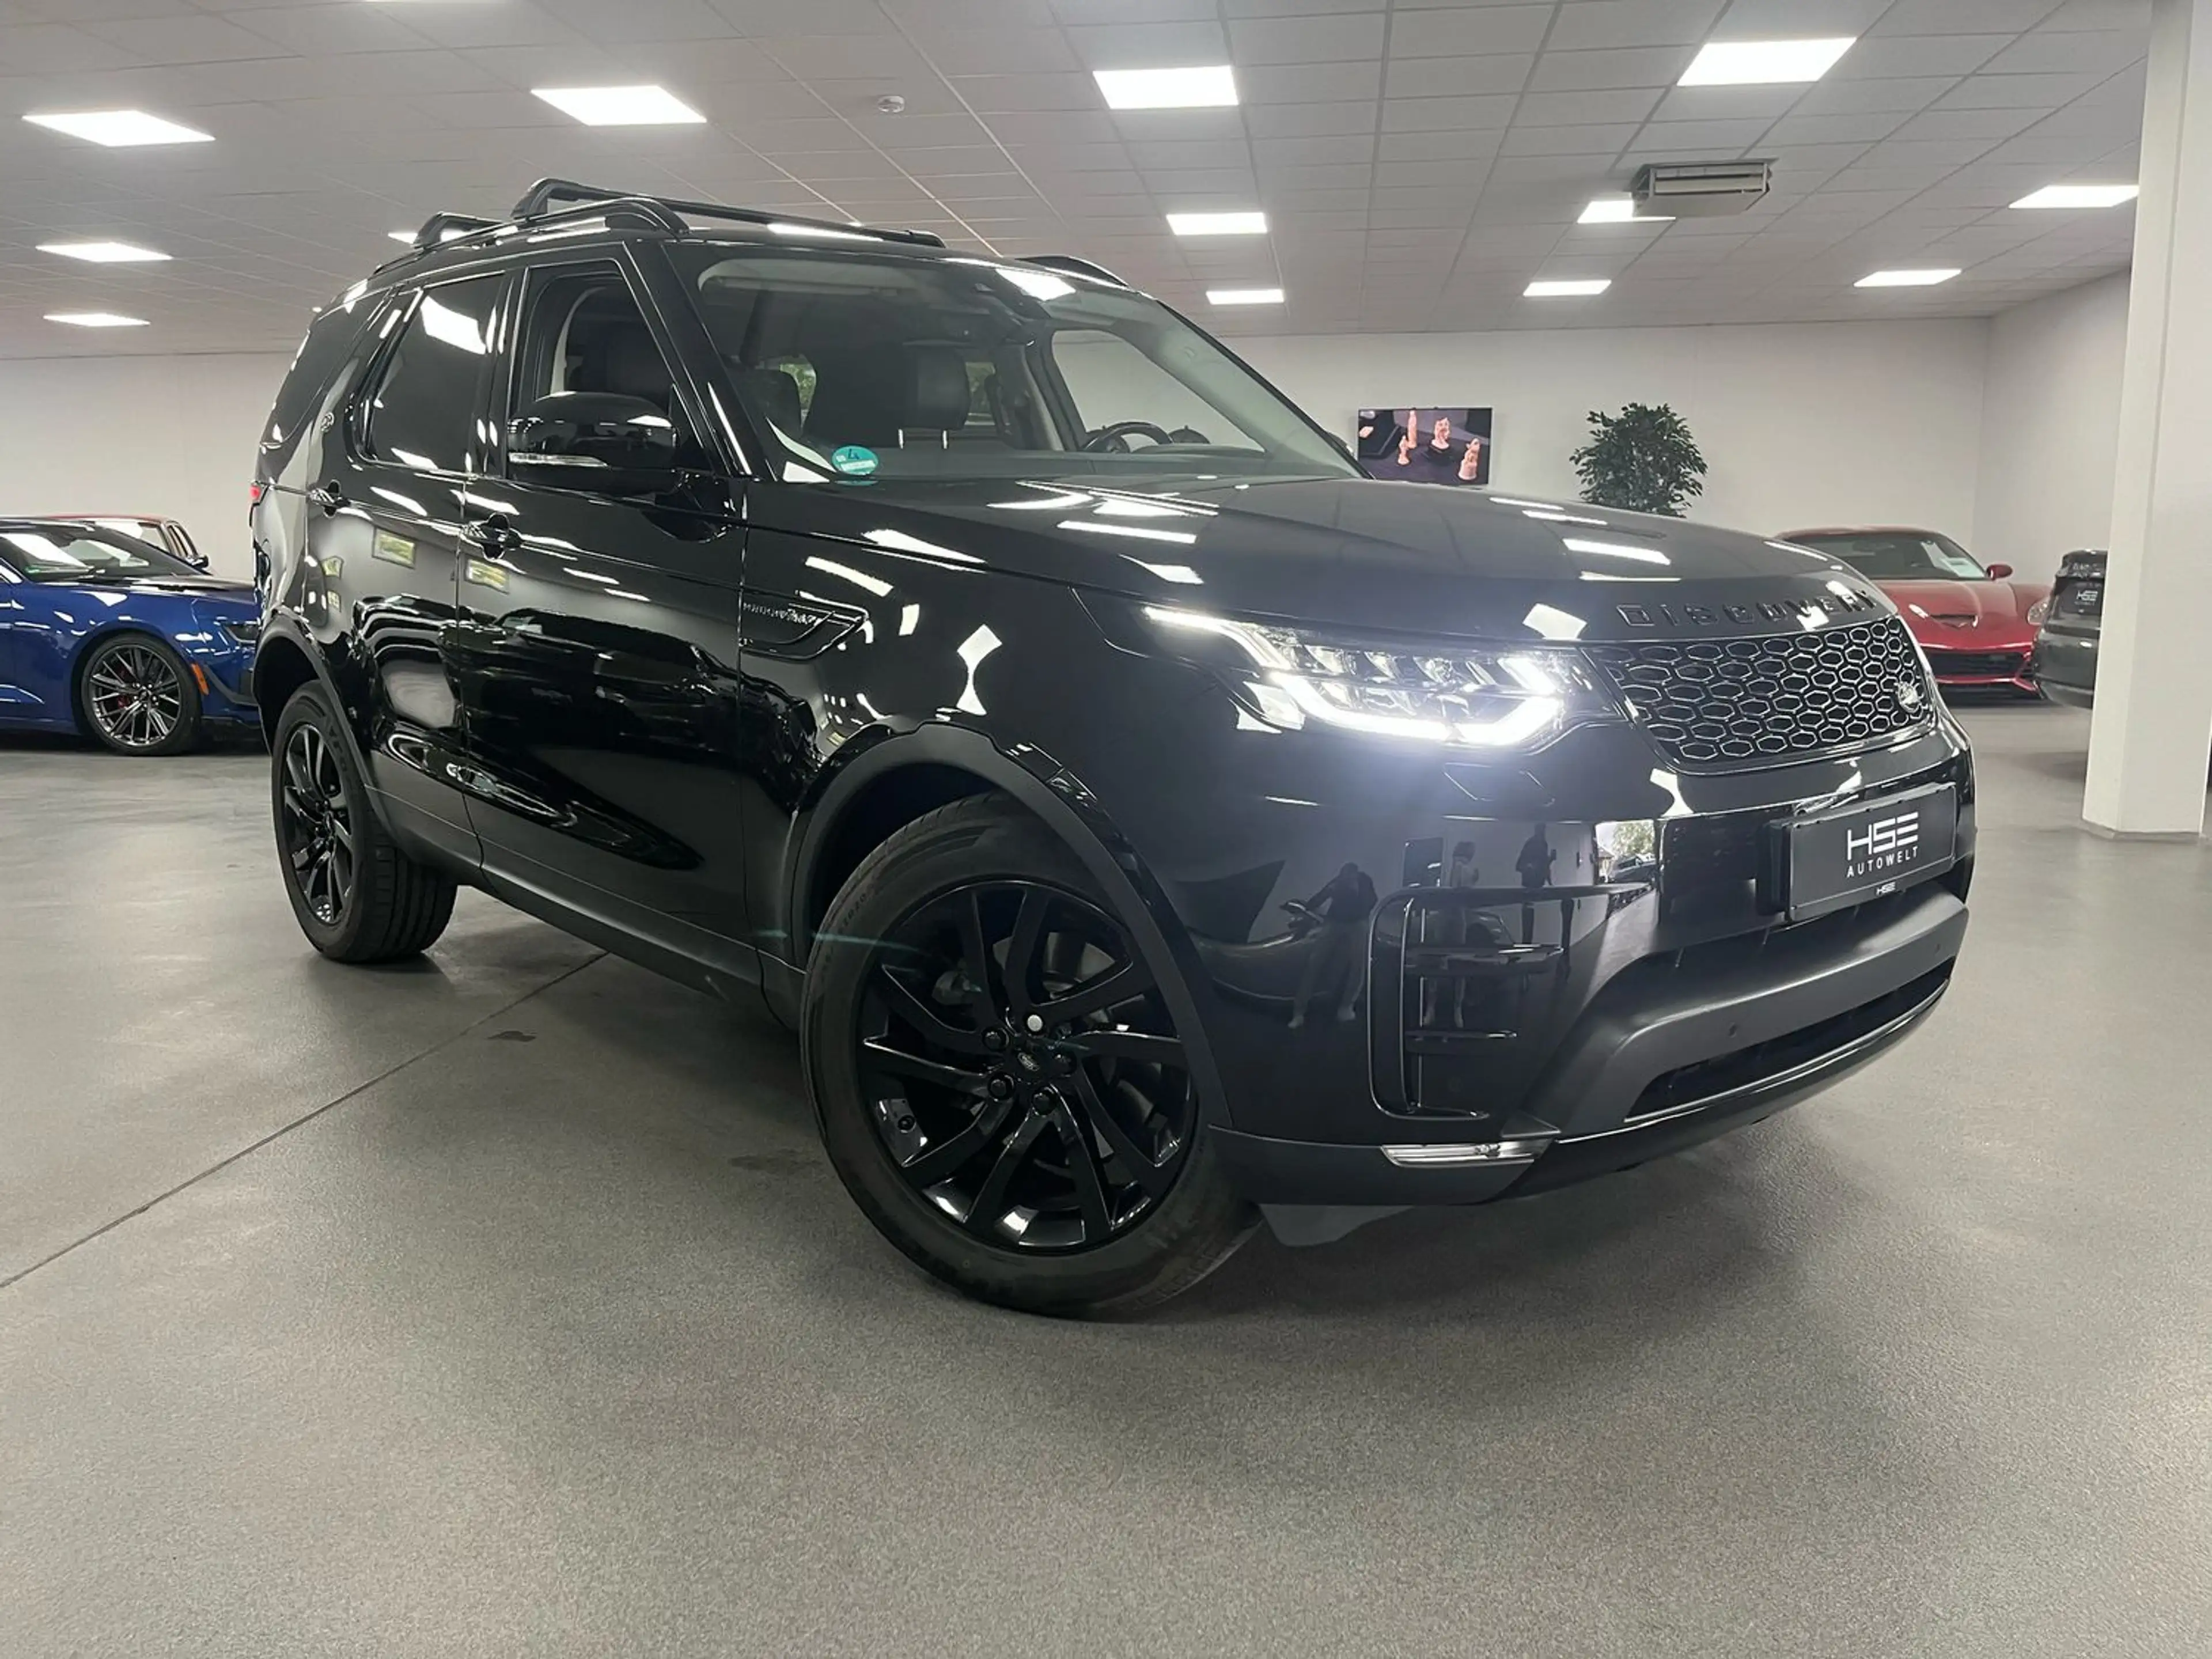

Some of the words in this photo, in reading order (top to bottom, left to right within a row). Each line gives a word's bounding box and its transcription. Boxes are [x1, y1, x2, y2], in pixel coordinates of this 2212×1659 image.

[1615, 589, 1876, 627] DISCOVERY
[1847, 811, 1919, 861] HSE
[1846, 845, 1918, 878] AUTOWELT
